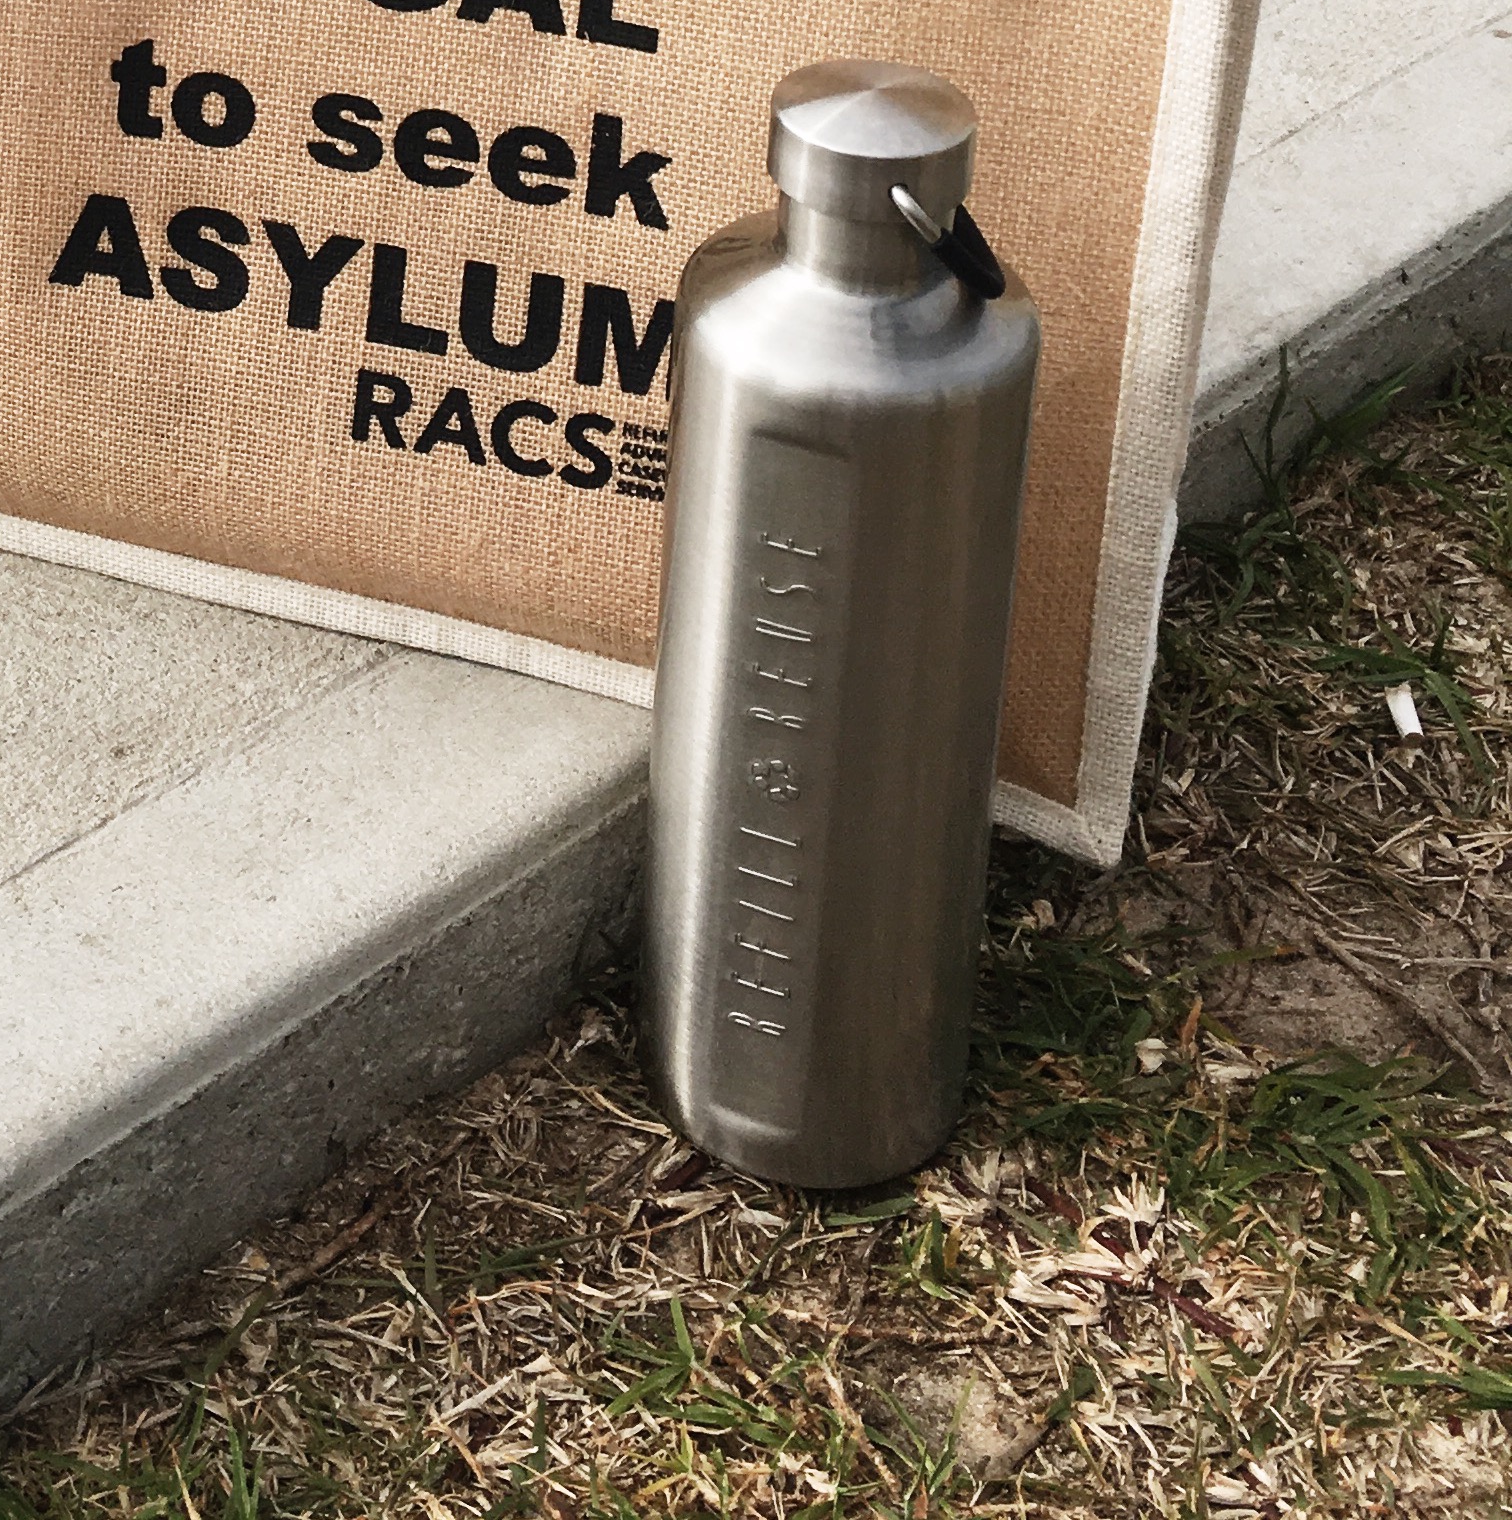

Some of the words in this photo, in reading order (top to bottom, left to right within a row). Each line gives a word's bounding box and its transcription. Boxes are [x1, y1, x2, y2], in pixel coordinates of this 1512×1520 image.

[110, 38, 257, 148] to
[307, 92, 673, 232] seek
[48, 193, 675, 402] ASYLUM
[349, 366, 615, 490] RACS
